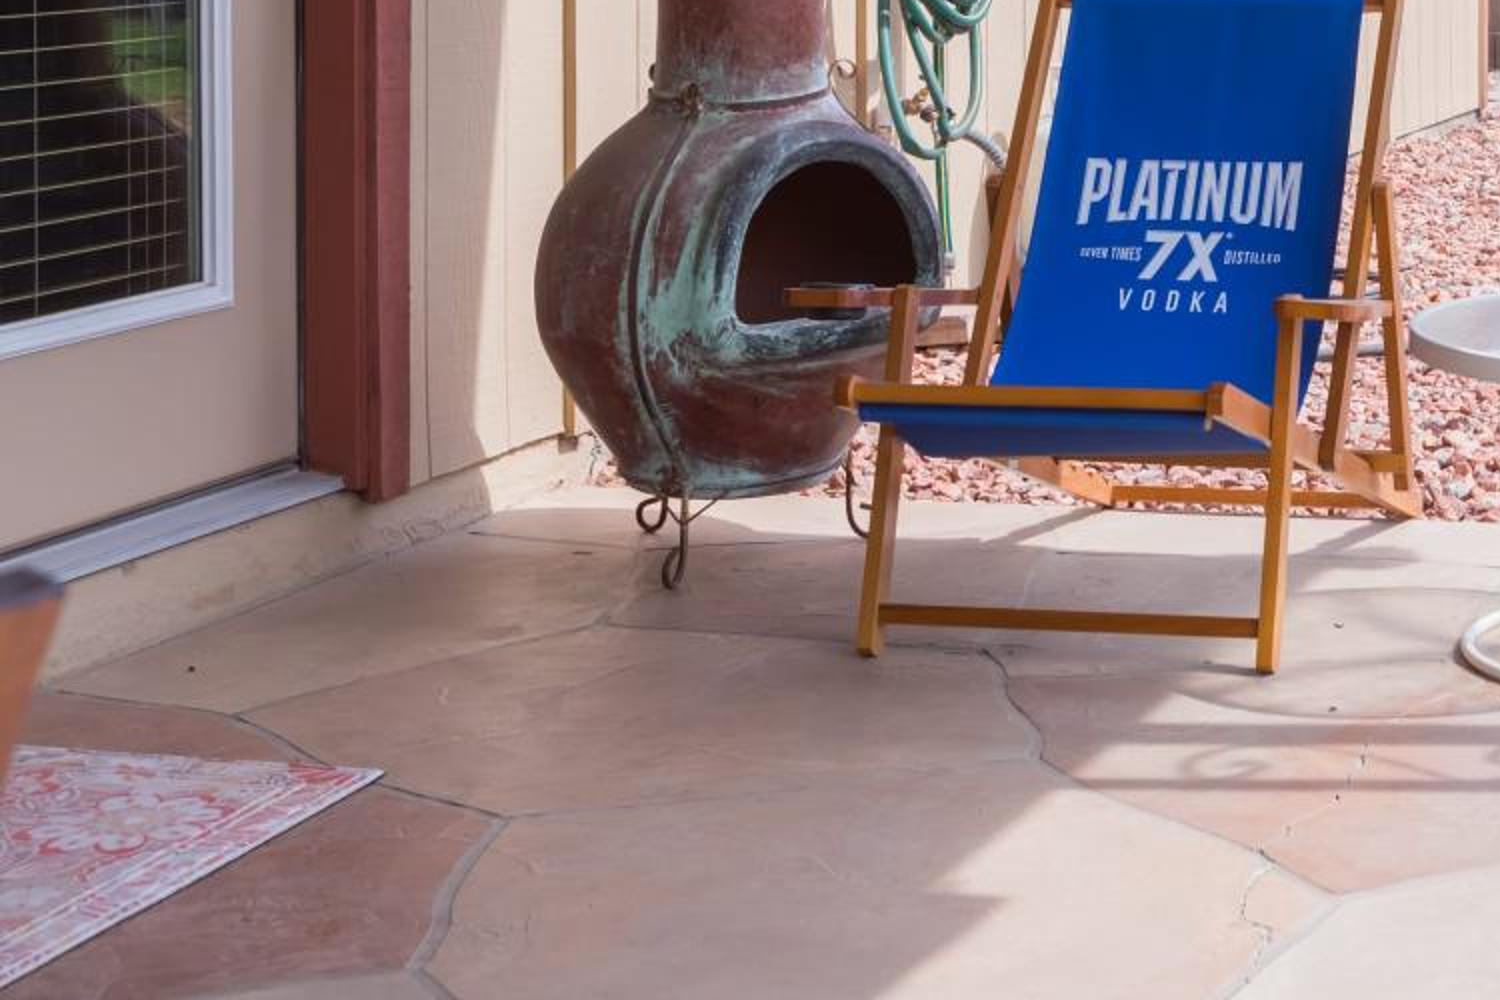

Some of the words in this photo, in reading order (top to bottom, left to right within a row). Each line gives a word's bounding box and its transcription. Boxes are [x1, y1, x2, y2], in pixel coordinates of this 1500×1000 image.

[1077, 157, 1303, 231] PLATINUM
[1112, 247, 1142, 262] TIMES
[1119, 288, 1228, 313] VODKA
